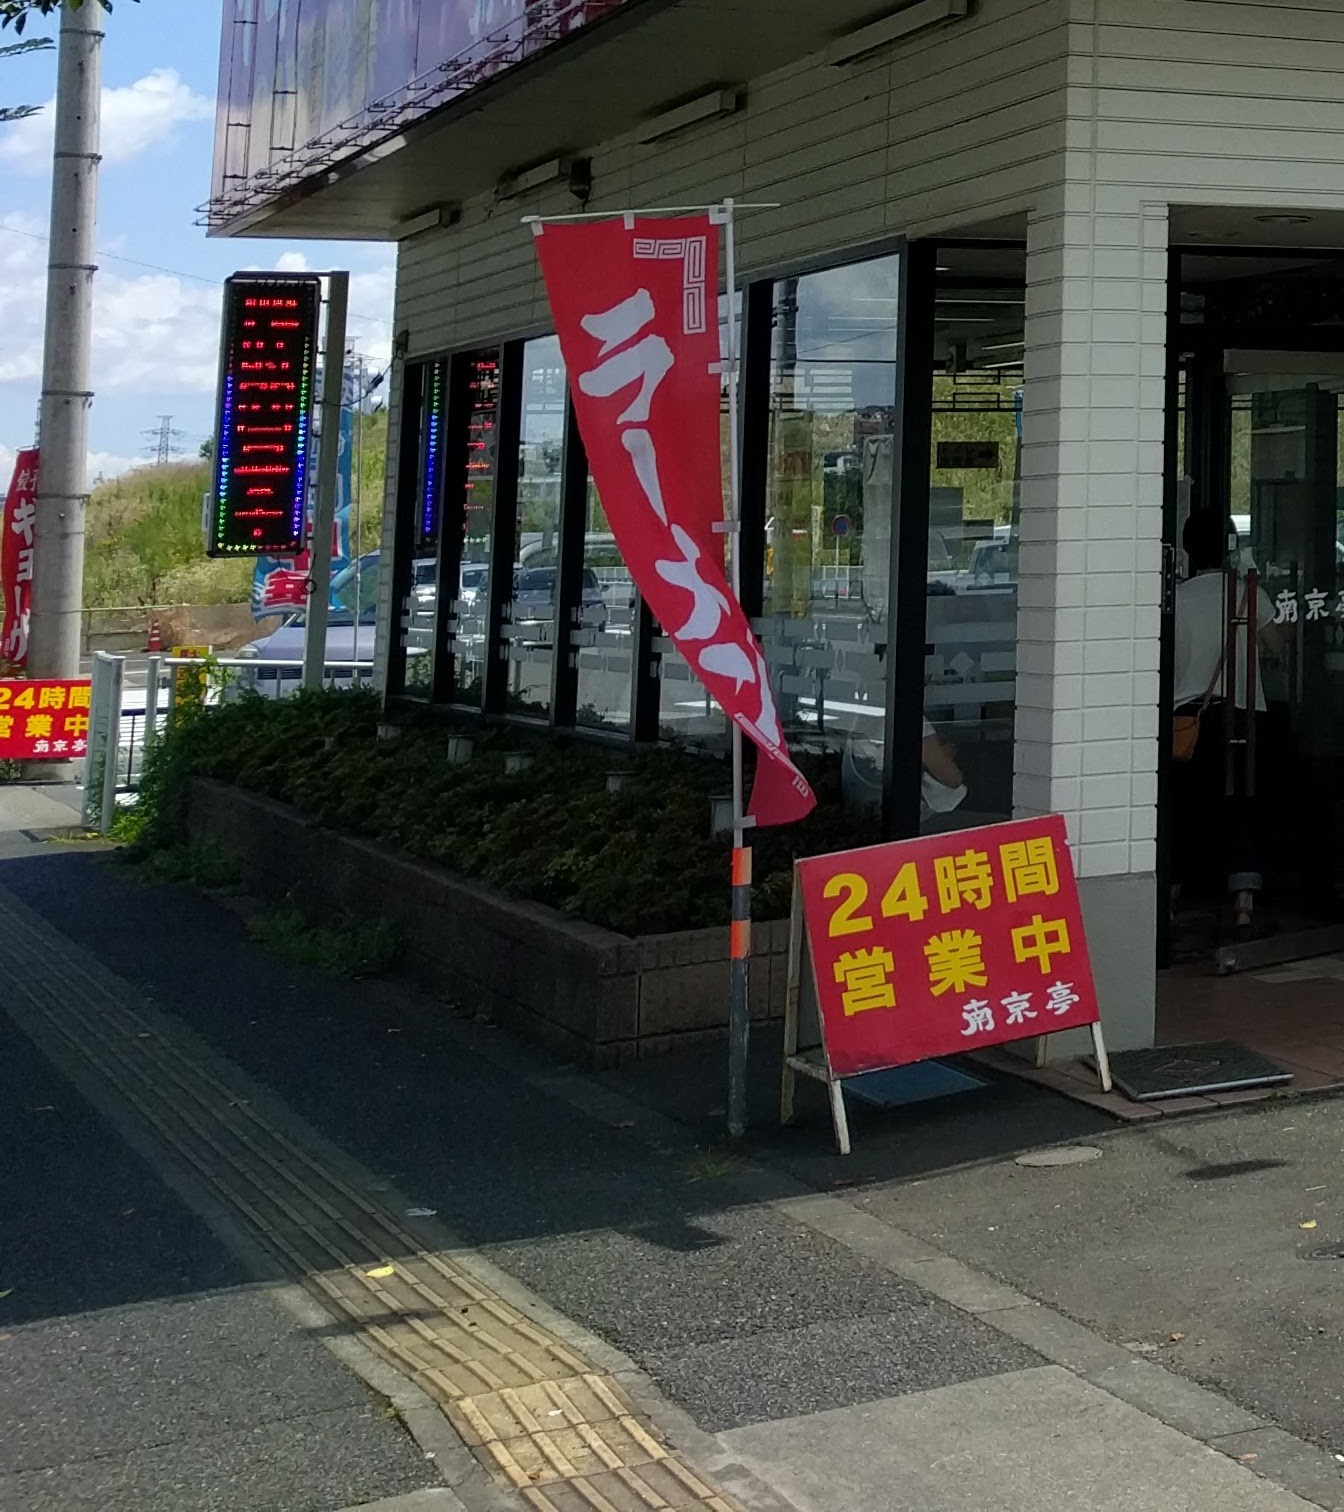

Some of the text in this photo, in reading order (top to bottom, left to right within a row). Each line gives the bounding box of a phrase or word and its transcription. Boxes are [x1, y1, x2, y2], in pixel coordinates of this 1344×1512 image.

[824, 837, 1059, 937] 24時間
[834, 916, 1070, 1016] 営業中
[961, 981, 1079, 1035] 南京亭
